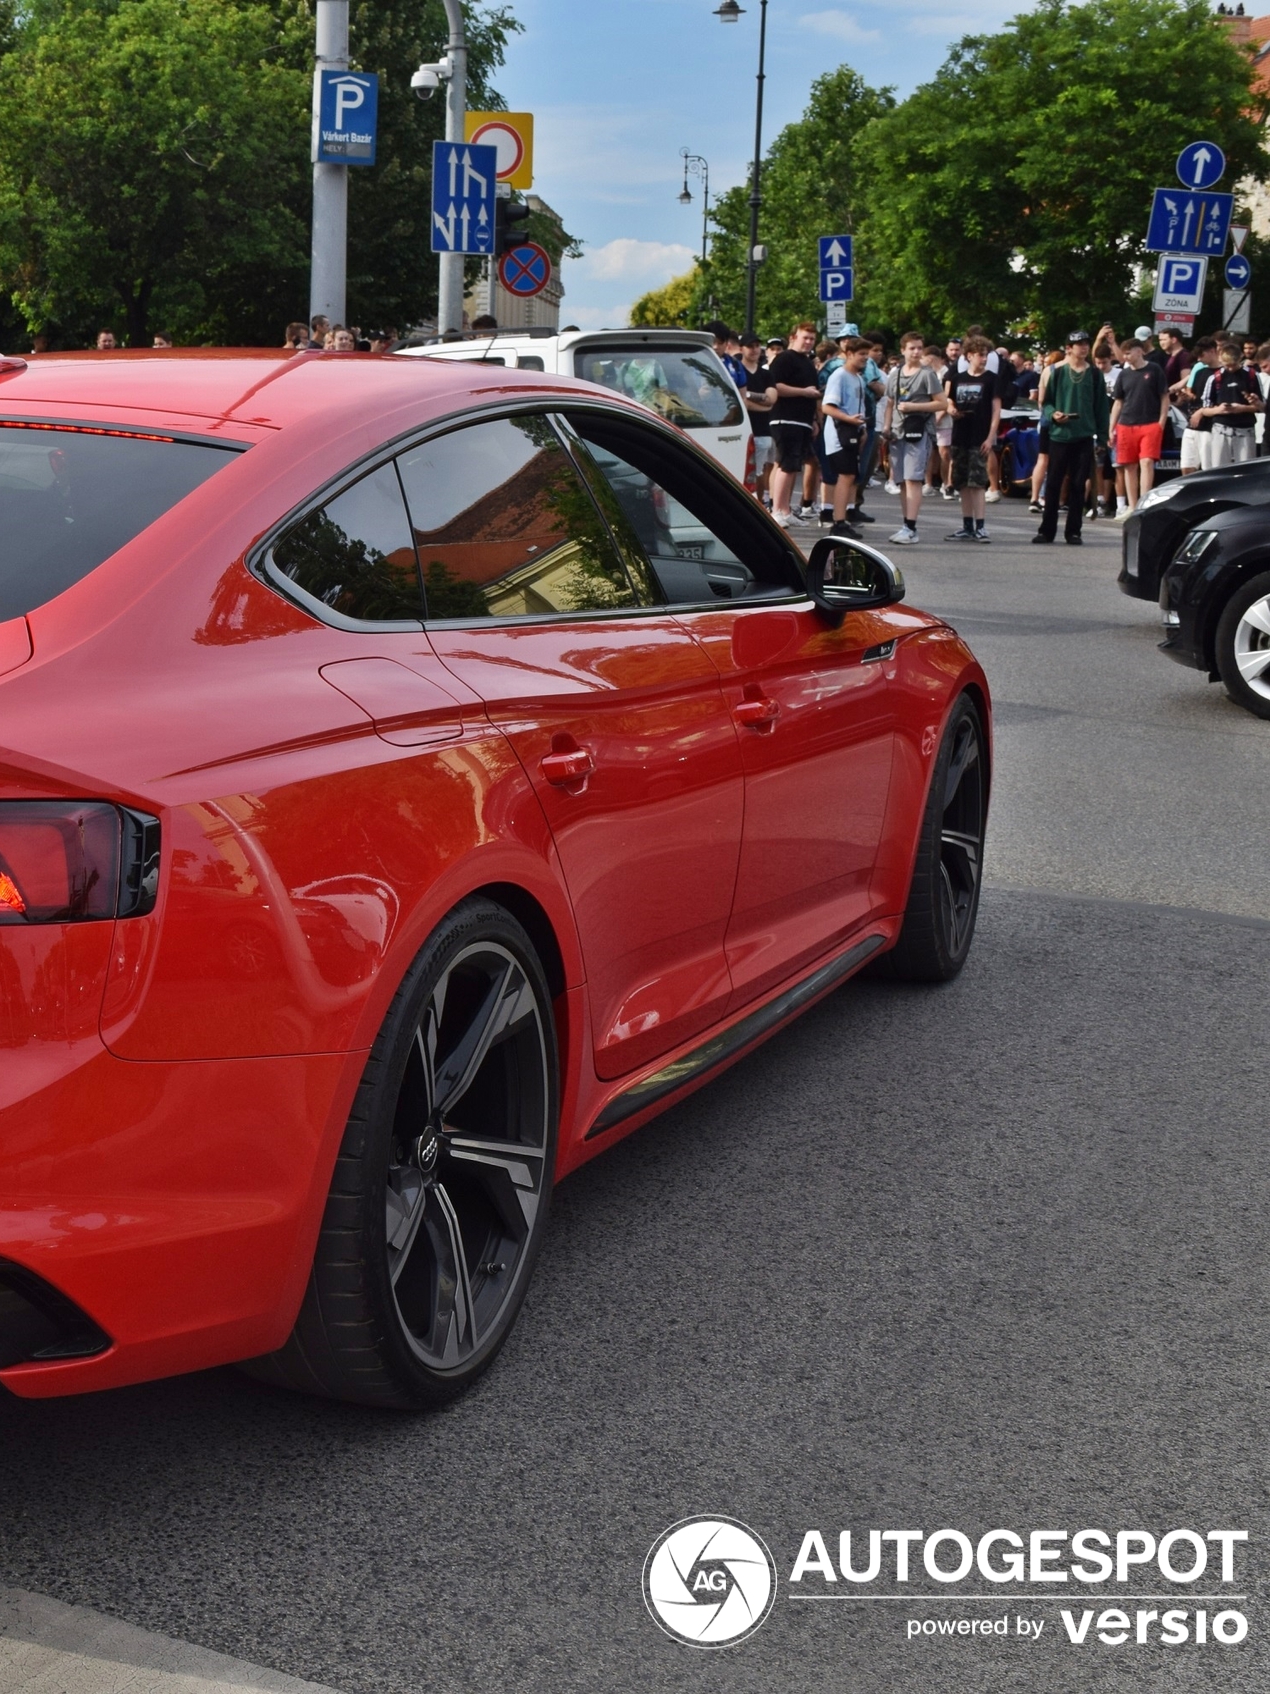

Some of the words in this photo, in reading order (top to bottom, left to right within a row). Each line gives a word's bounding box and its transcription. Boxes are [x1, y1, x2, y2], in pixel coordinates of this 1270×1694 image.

[335, 84, 364, 130] P
[322, 131, 349, 142] Várkert
[350, 132, 372, 143] Bazár
[827, 273, 845, 298] P
[1168, 263, 1193, 292] P
[1165, 298, 1189, 308] ZÓNA
